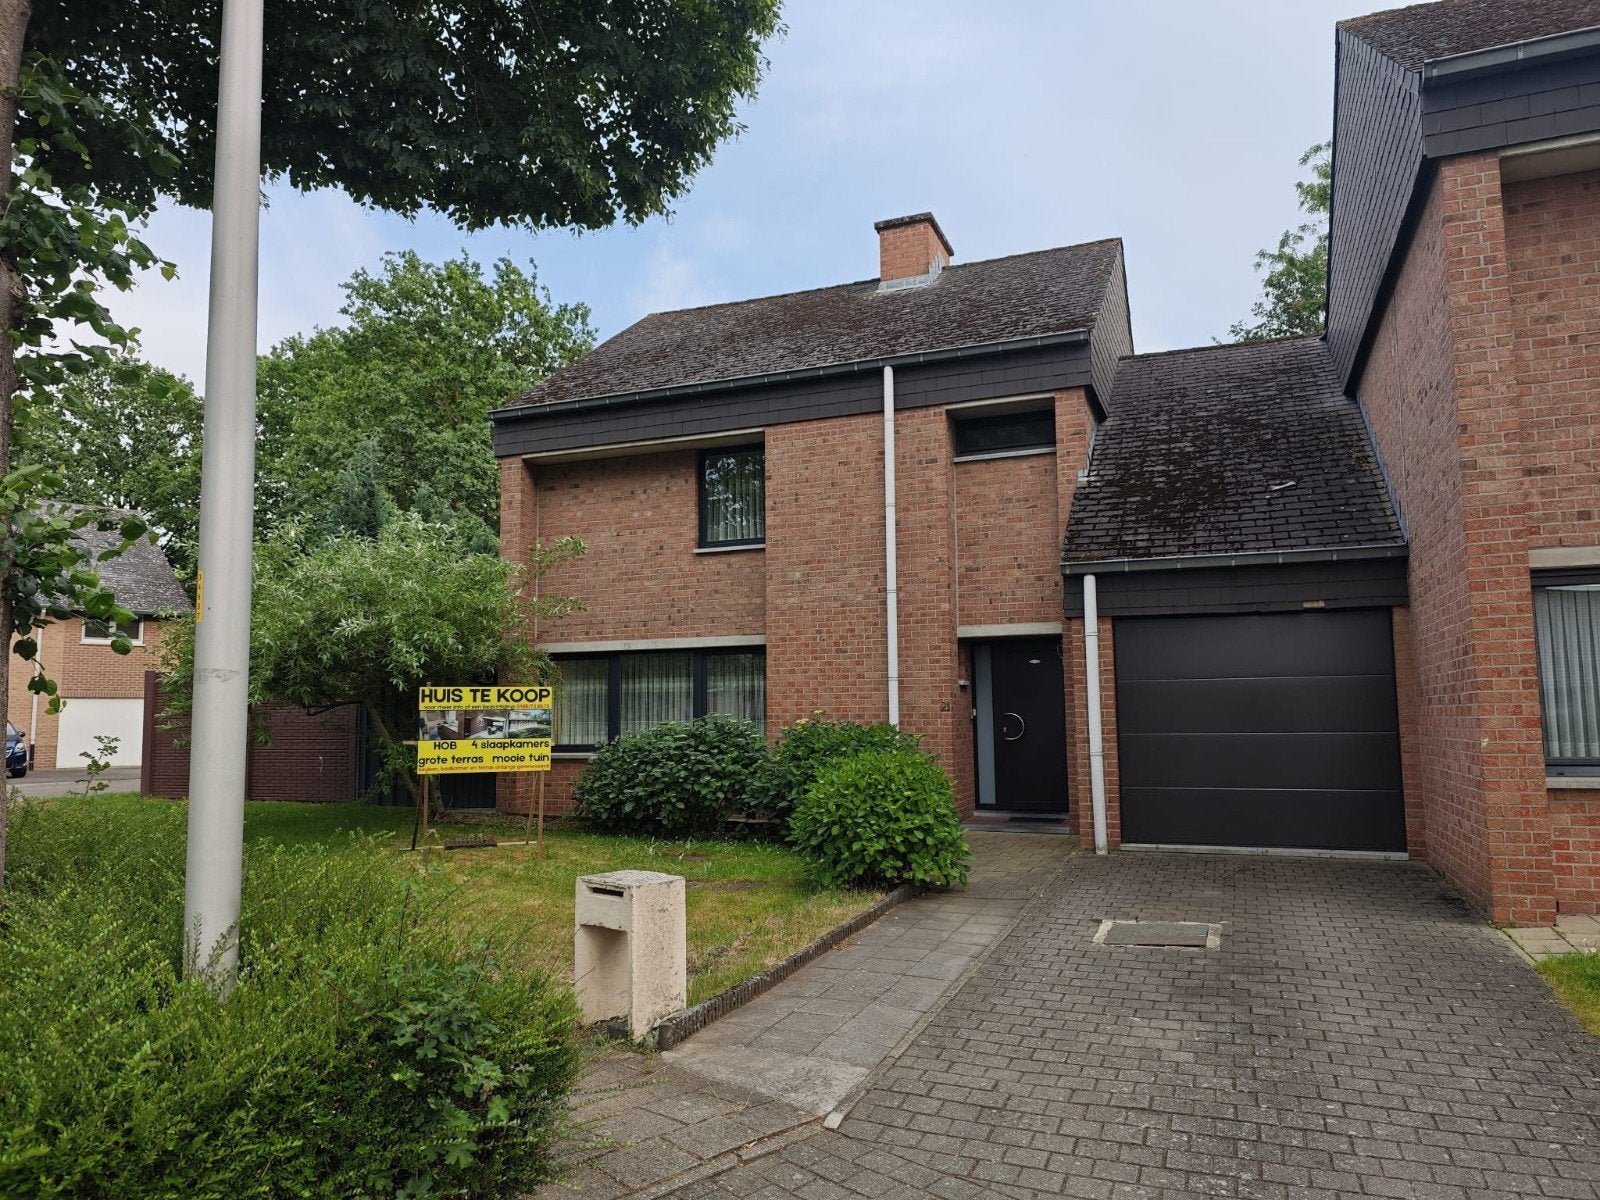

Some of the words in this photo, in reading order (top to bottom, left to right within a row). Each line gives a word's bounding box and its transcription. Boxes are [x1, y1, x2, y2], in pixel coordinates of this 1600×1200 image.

[421, 688, 463, 702] HUIS
[469, 688, 491, 702] TE
[497, 688, 551, 703] KOOP
[433, 741, 457, 750] HOB
[472, 740, 478, 749] 4
[480, 739, 550, 751] slaapkamers
[418, 756, 448, 768] grote
[451, 755, 484, 764] terras
[492, 753, 526, 763] mooie
[529, 752, 549, 762] tuin
